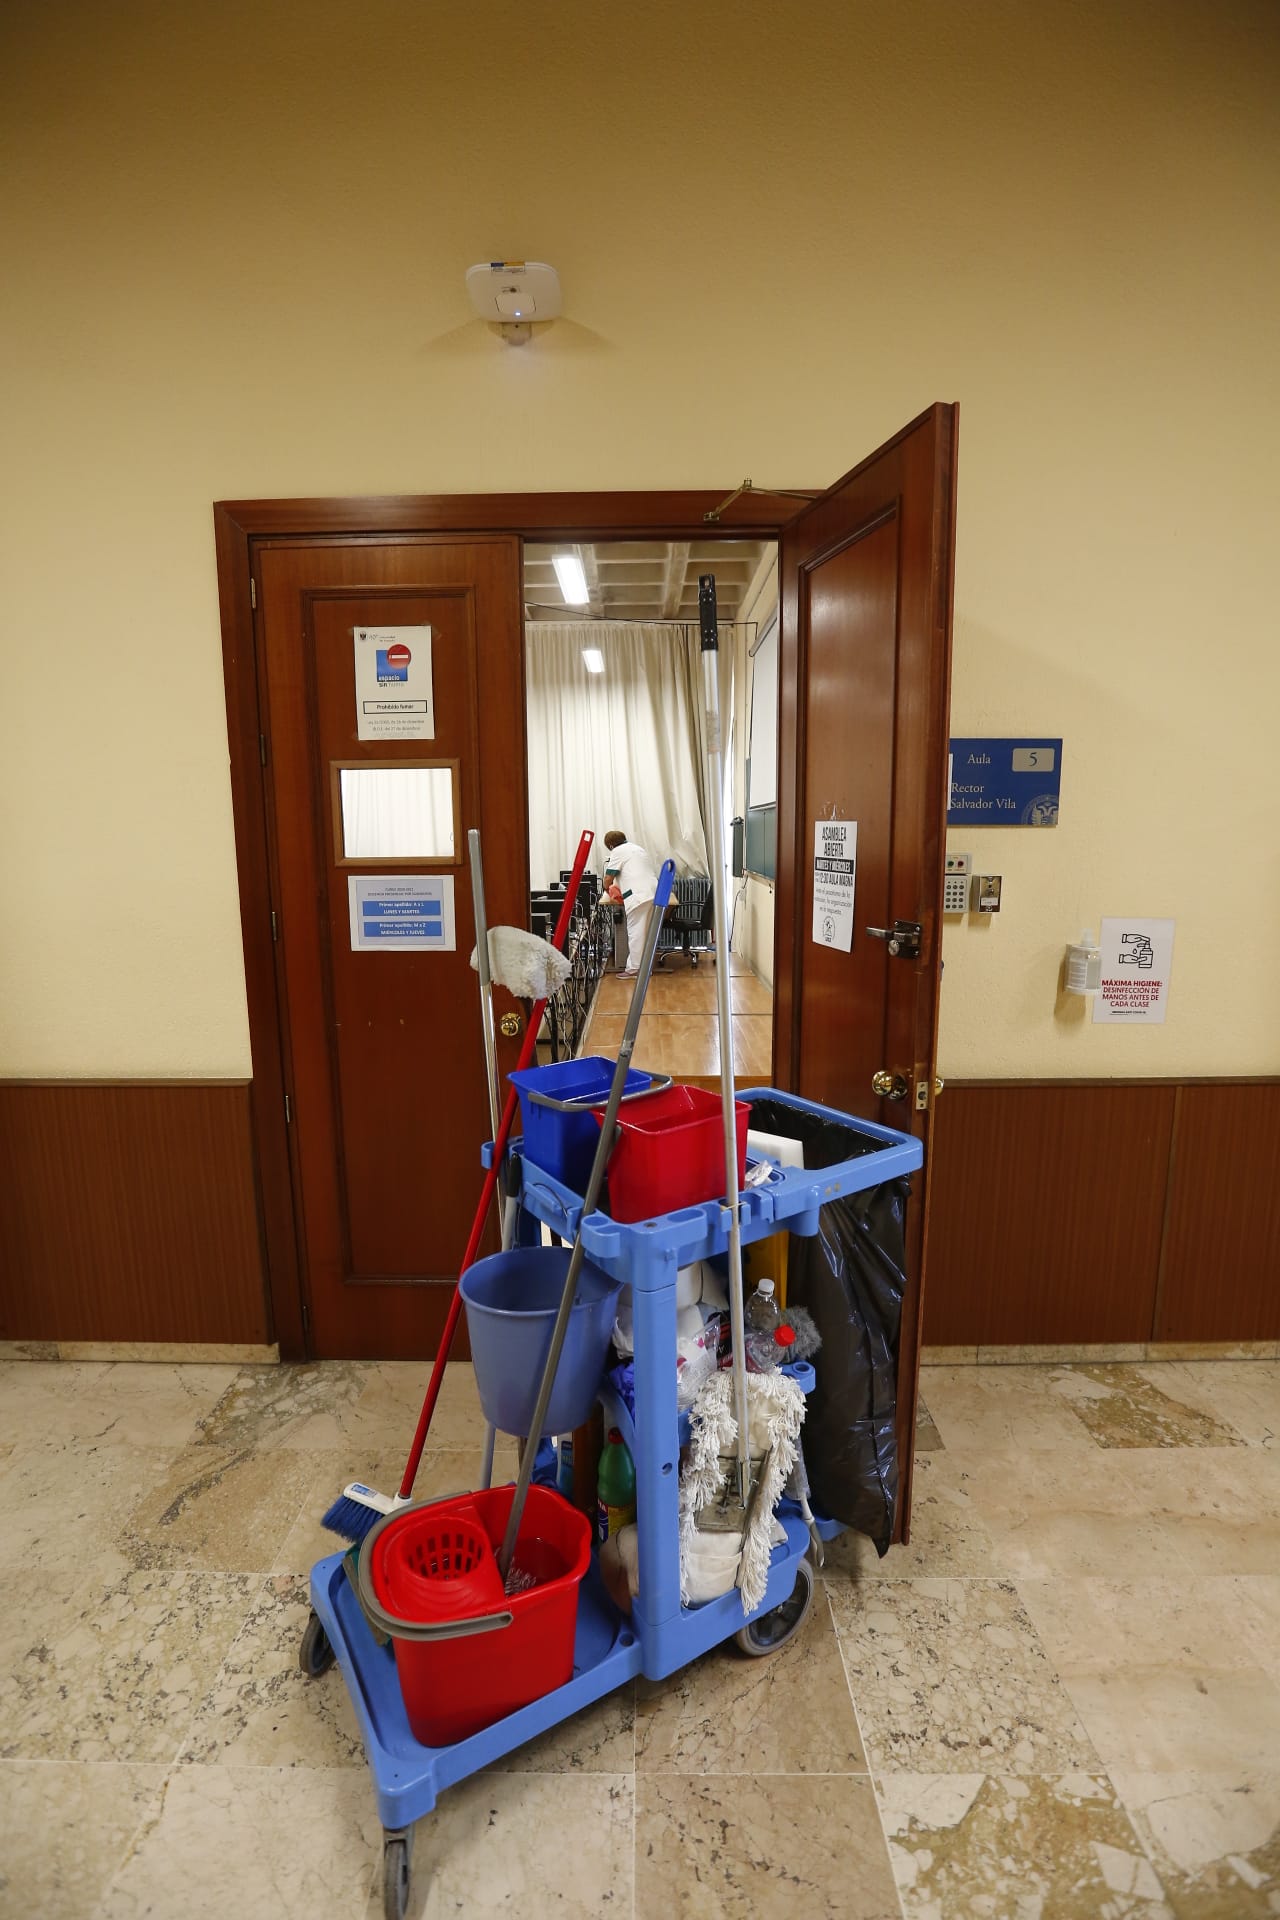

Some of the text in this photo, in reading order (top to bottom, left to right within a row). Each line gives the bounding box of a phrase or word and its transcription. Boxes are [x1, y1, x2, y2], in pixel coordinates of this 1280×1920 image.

[967, 752, 1038, 767] Aula 5
[951, 782, 985, 793] Rector
[950, 797, 1016, 809] Salvador Vila
[822, 826, 847, 841] ASAMBLEA
[824, 842, 844, 857] ABIERTA
[829, 873, 839, 886] AULA
[839, 874, 853, 887] MAGNA
[1101, 978, 1132, 987] MÁXIMA
[1103, 986, 1150, 994] DESINFECCIÓN
